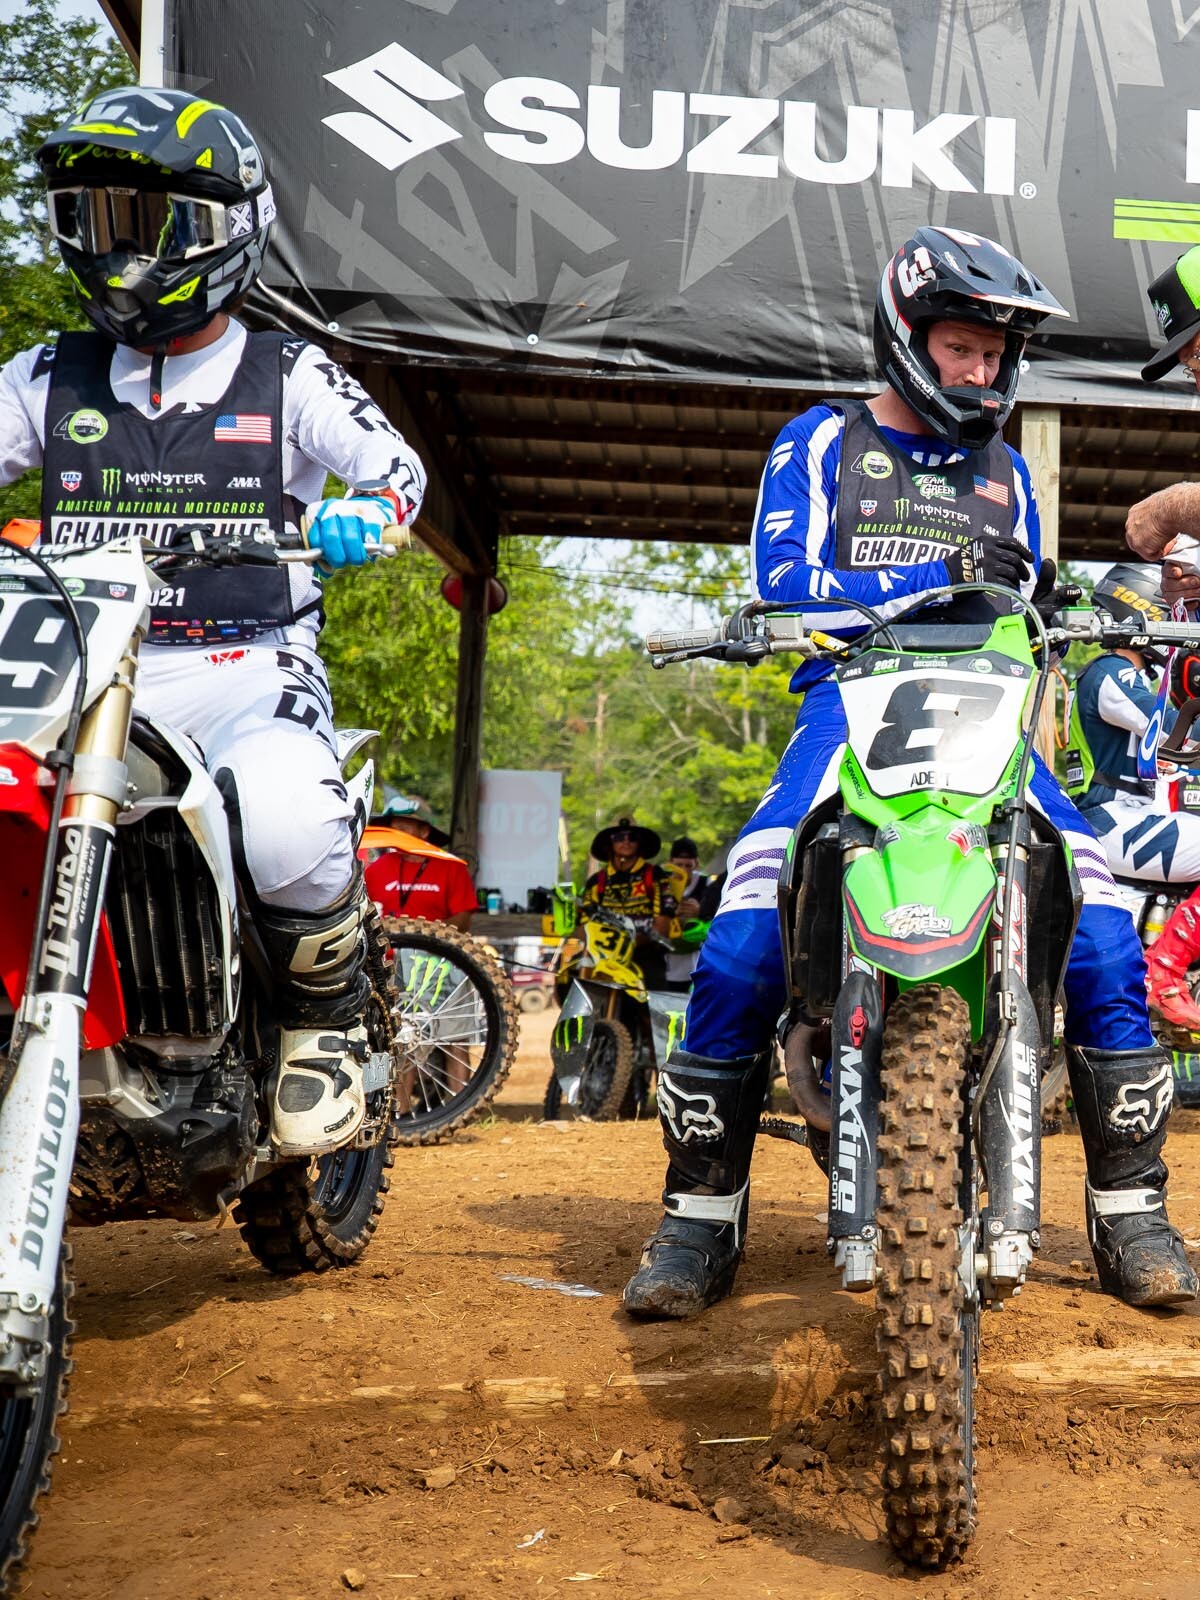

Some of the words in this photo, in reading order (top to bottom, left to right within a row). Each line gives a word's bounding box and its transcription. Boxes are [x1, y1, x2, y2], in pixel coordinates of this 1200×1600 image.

[483, 75, 1016, 196] SUZUKI
[125, 470, 207, 486] MONSTER
[56, 499, 110, 513] AMATEUR
[116, 501, 178, 515] NATIONAL
[184, 501, 266, 515] MOTOCROSS
[913, 503, 971, 525] MONSTER
[856, 523, 902, 534] AMATEUR
[905, 526, 951, 540] NATIONAL
[873, 657, 900, 672] 2021
[866, 678, 1005, 770] 8
[844, 758, 867, 800] Kawasaki
[19, 1056, 70, 1271] DUNLOP
